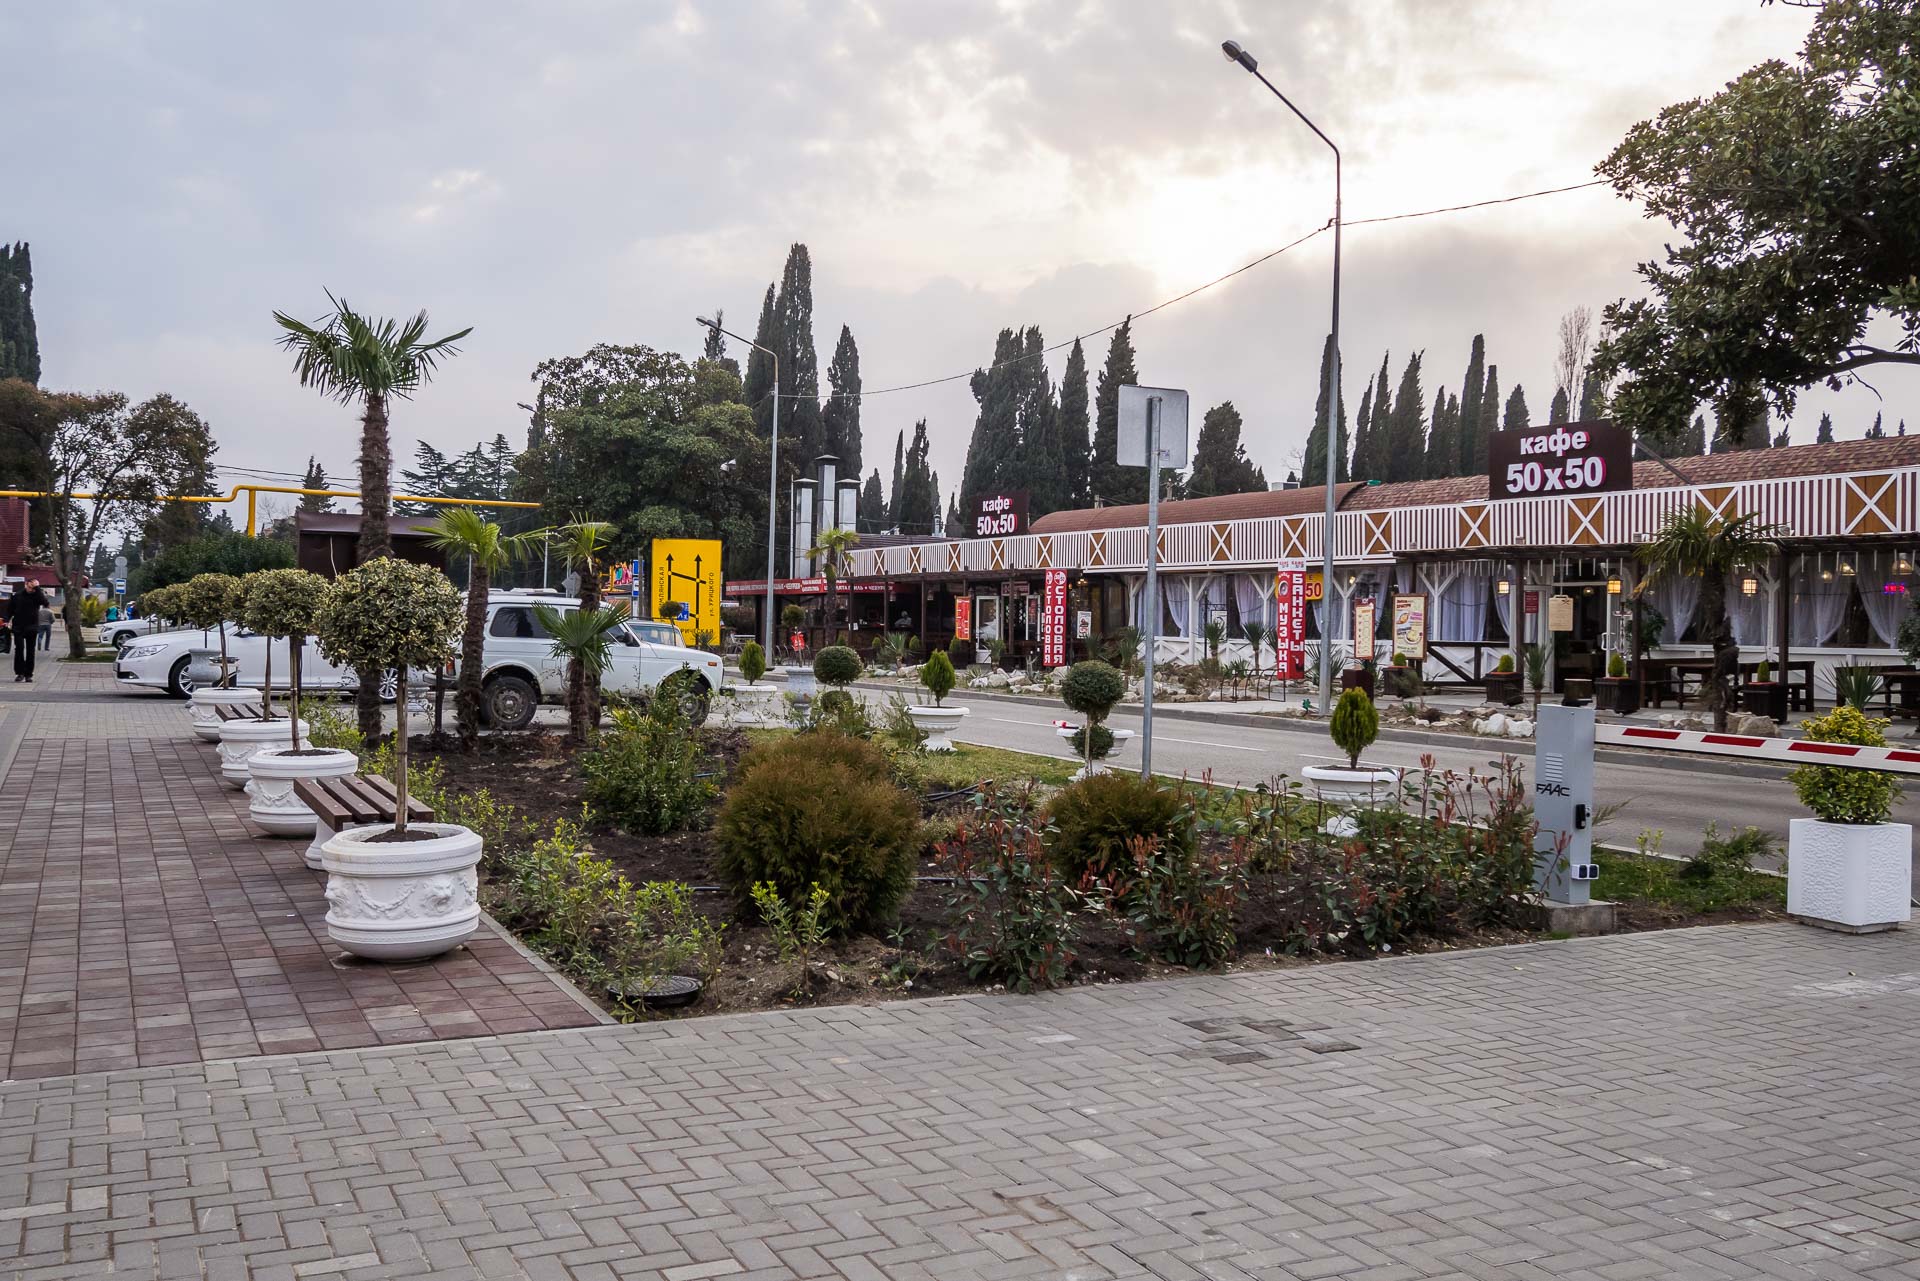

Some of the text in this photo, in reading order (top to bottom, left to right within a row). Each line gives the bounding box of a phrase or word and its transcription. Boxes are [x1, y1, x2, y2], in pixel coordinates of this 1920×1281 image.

[1520, 428, 1589, 457] кафе
[982, 495, 1011, 514] кафе
[1044, 585, 1053, 664] СТОЛОВАЯ
[1053, 585, 1065, 664] СТОЛОВАЯ
[1277, 602, 1289, 673] МУЗЫКА
[1290, 573, 1305, 653] БАНКЕТЫ
[1536, 783, 1570, 797] FAAC
